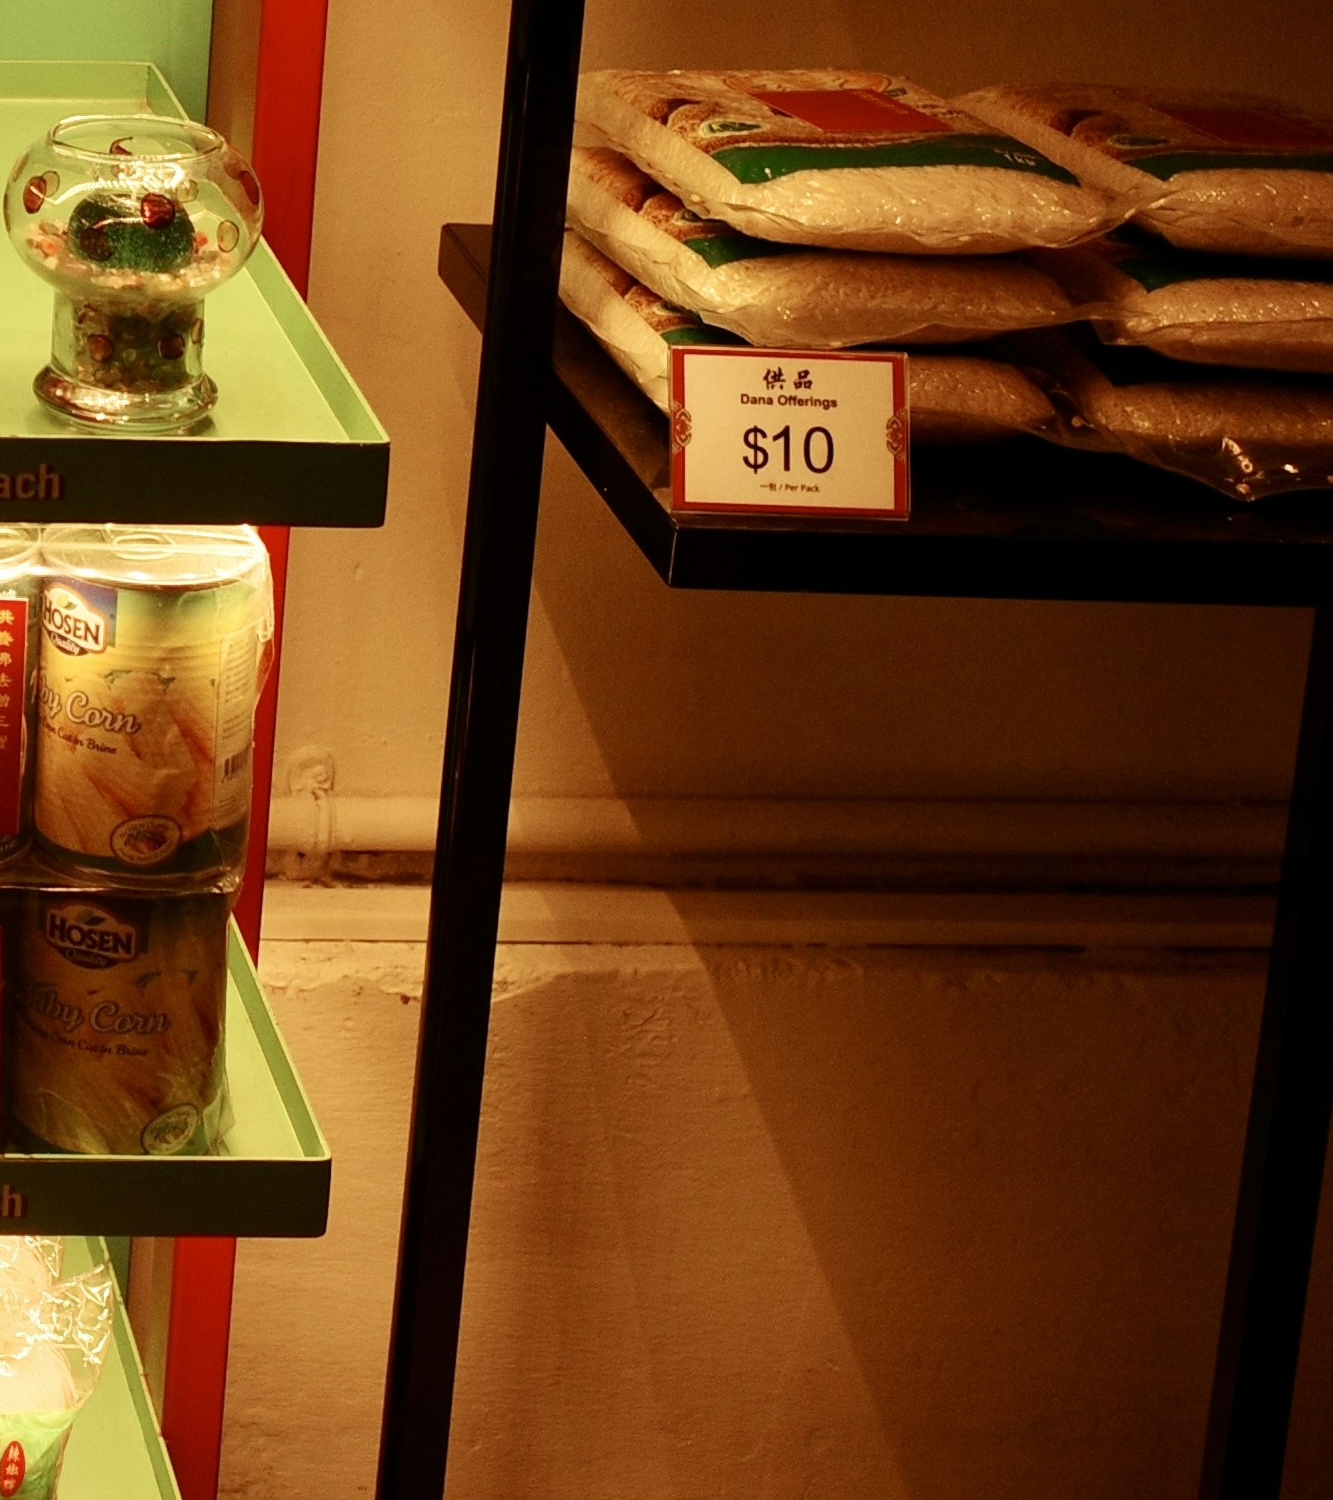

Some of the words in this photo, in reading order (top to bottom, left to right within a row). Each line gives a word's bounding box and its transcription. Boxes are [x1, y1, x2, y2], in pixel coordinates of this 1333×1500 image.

[762, 366, 814, 391] 供品
[739, 392, 774, 406] Dana
[777, 394, 839, 411] Offerings
[741, 424, 835, 475] $10
[41, 592, 102, 647] HOSEN
[50, 631, 81, 656] Quality
[65, 690, 142, 734] Corn
[86, 737, 118, 755] Brine
[49, 913, 133, 954] HOSEN
[65, 949, 108, 966] Quality
[90, 1000, 171, 1035] Corn
